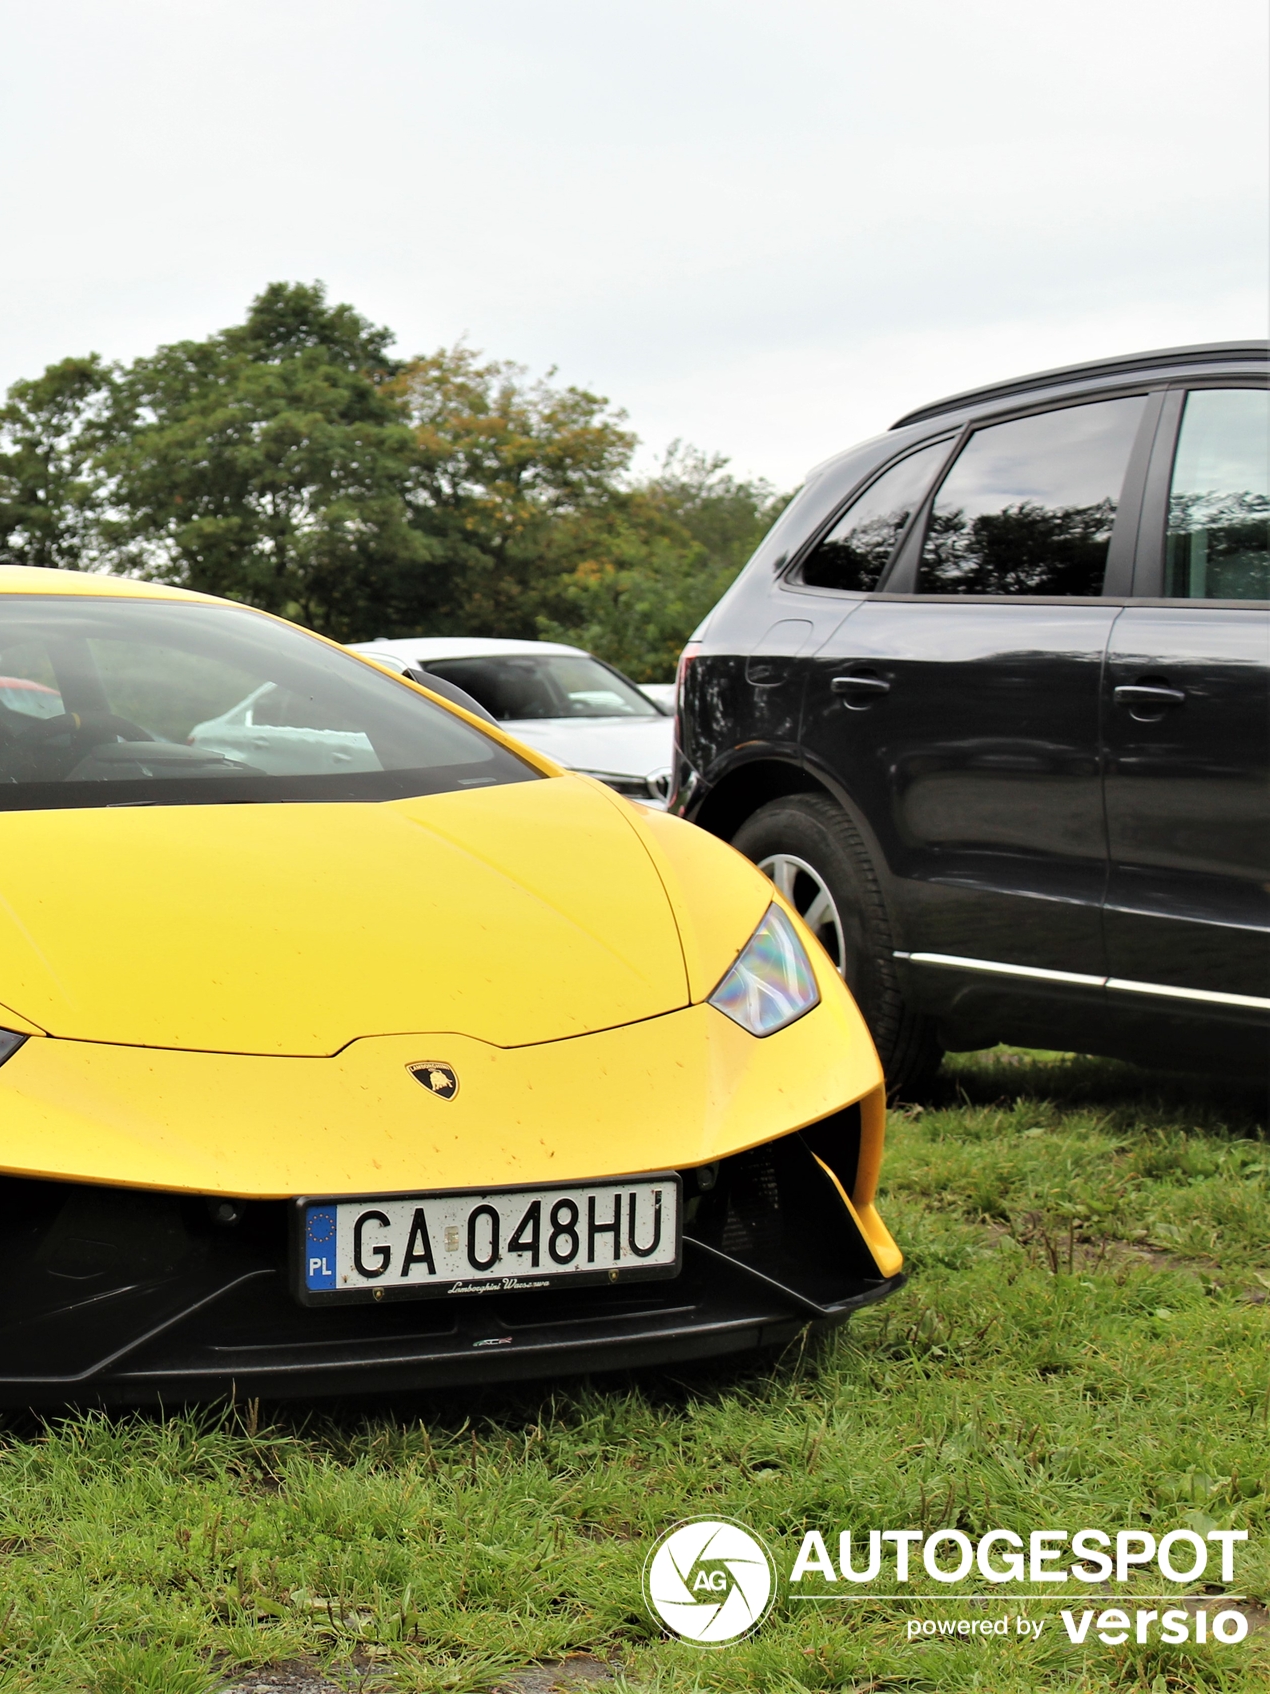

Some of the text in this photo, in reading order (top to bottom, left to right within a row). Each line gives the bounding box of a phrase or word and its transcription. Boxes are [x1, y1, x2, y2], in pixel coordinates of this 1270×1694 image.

[352, 1189, 663, 1279] GA 048HU
[308, 1257, 332, 1277] PL
[447, 1281, 501, 1294] Lamborghini
